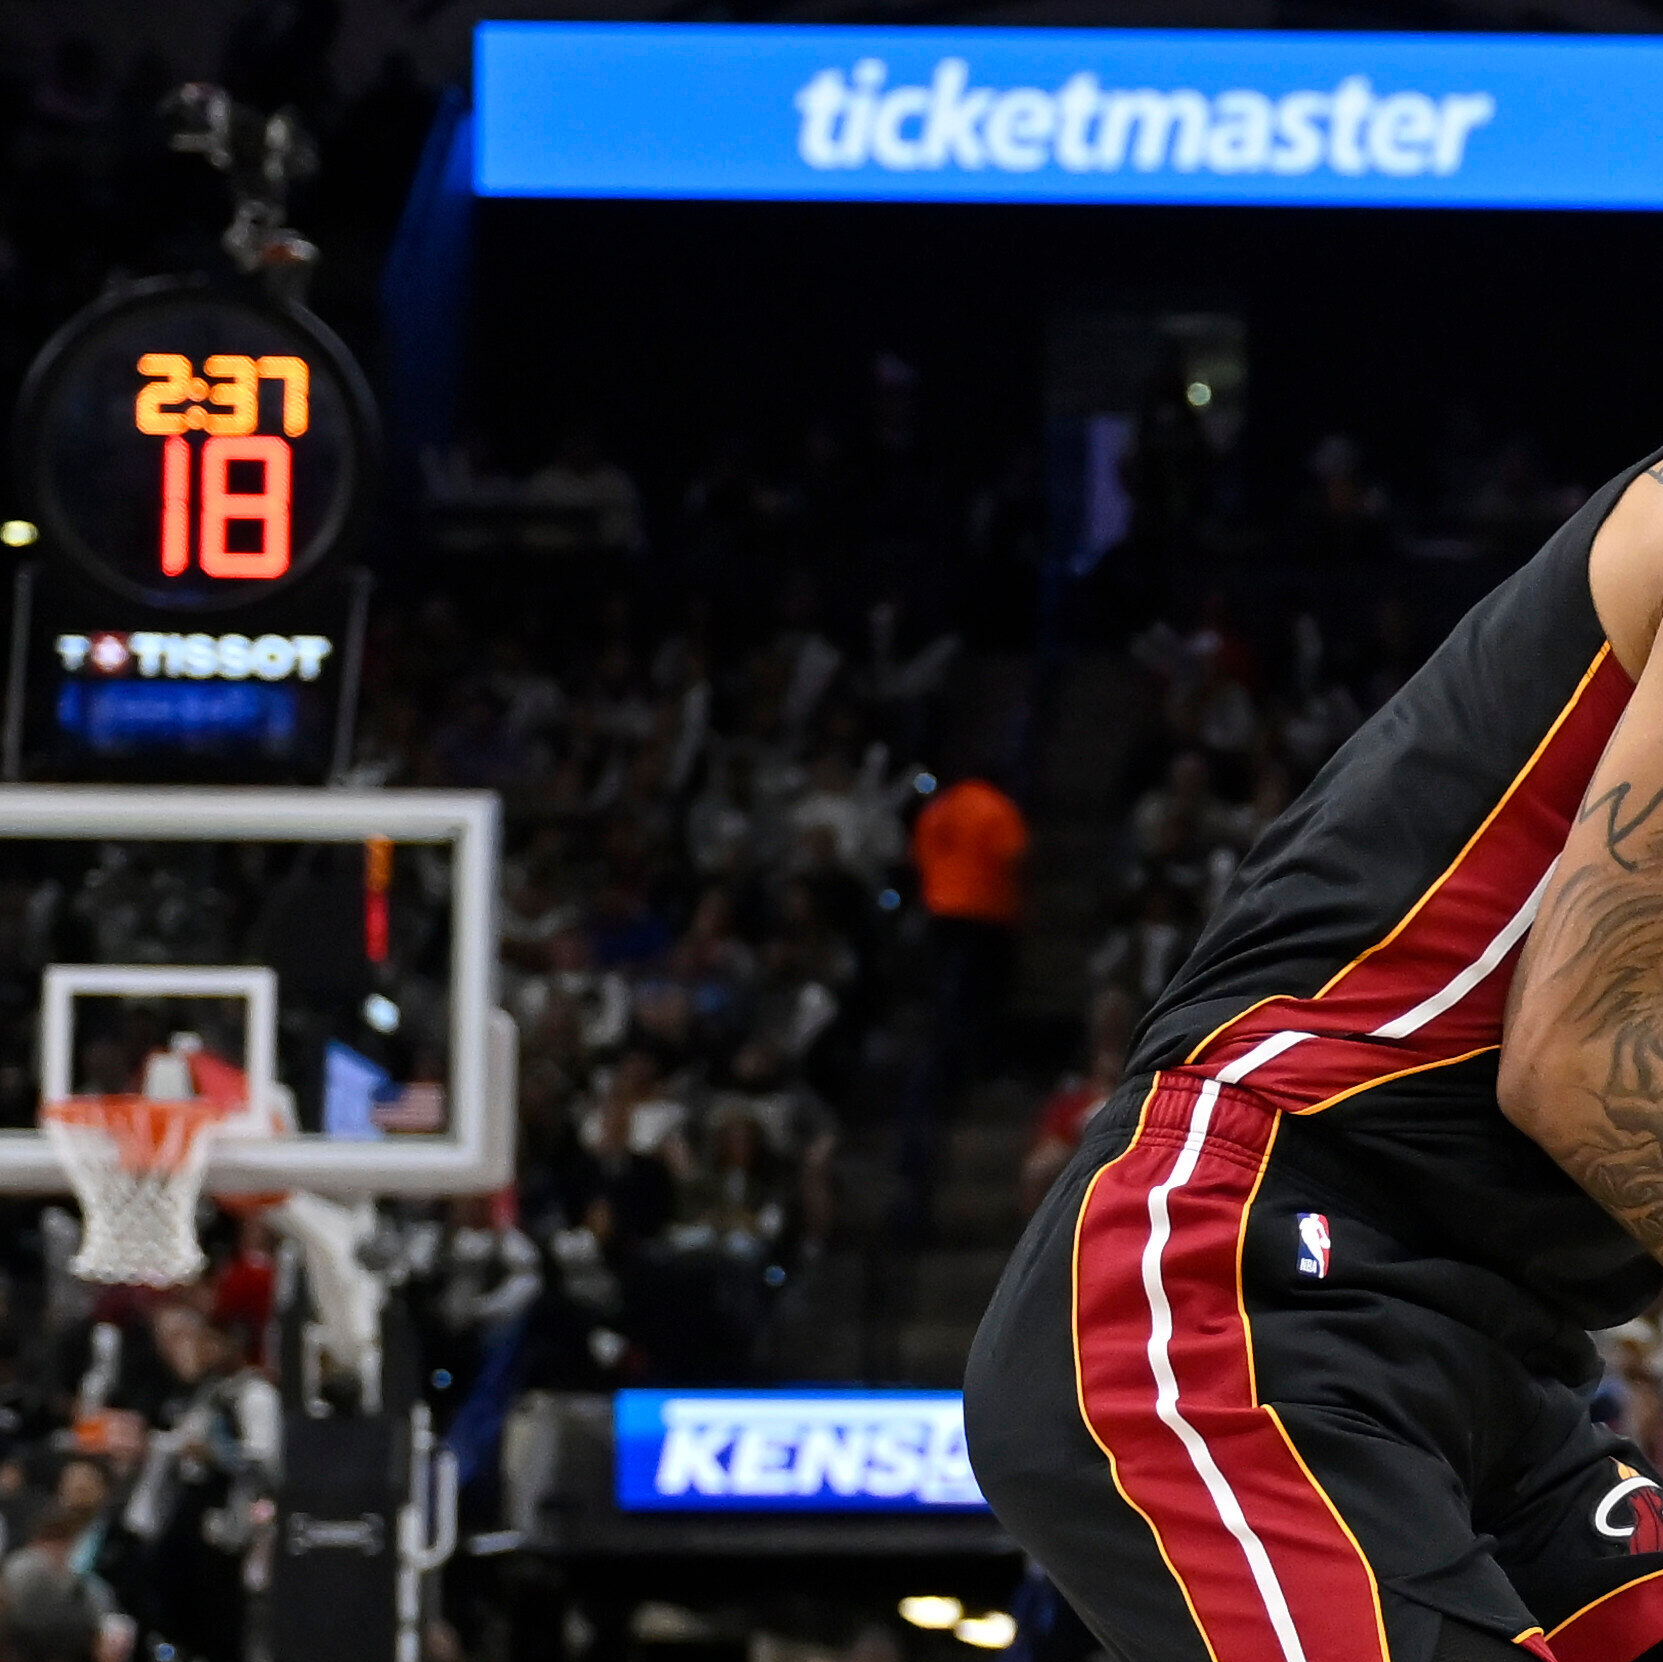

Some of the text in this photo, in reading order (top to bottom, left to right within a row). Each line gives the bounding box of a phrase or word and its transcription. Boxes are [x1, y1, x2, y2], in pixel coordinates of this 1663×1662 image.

[798, 57, 1493, 177] ticketmaster
[136, 353, 309, 437] 2:37
[161, 435, 291, 579] 18
[130, 632, 332, 682] TISSOT
